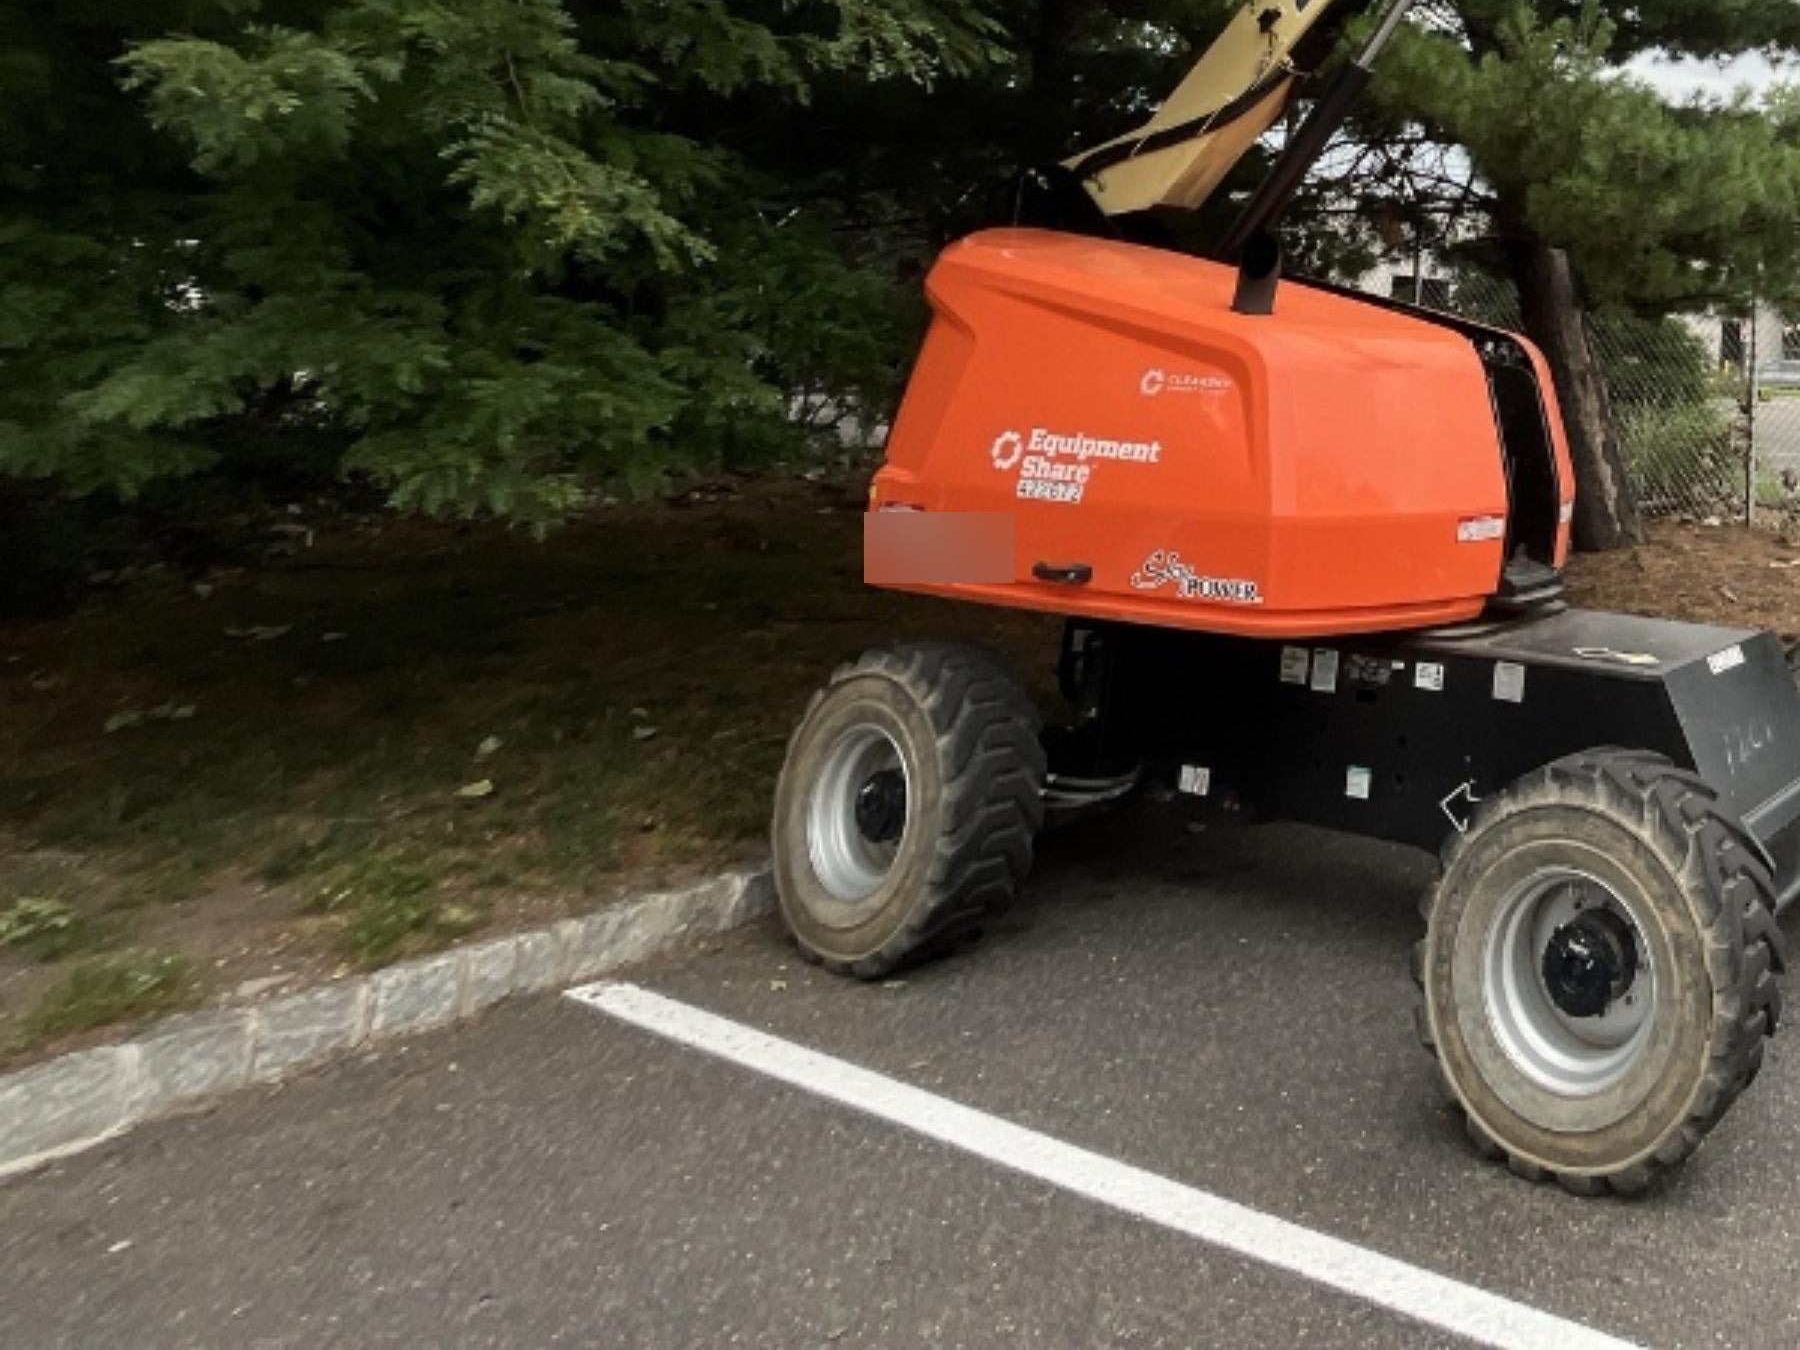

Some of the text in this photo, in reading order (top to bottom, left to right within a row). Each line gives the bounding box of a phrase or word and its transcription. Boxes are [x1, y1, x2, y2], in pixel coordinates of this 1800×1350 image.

[1027, 427, 1162, 463] Equipment
[1019, 455, 1091, 484] Share
[1185, 577, 1258, 602] POWER
